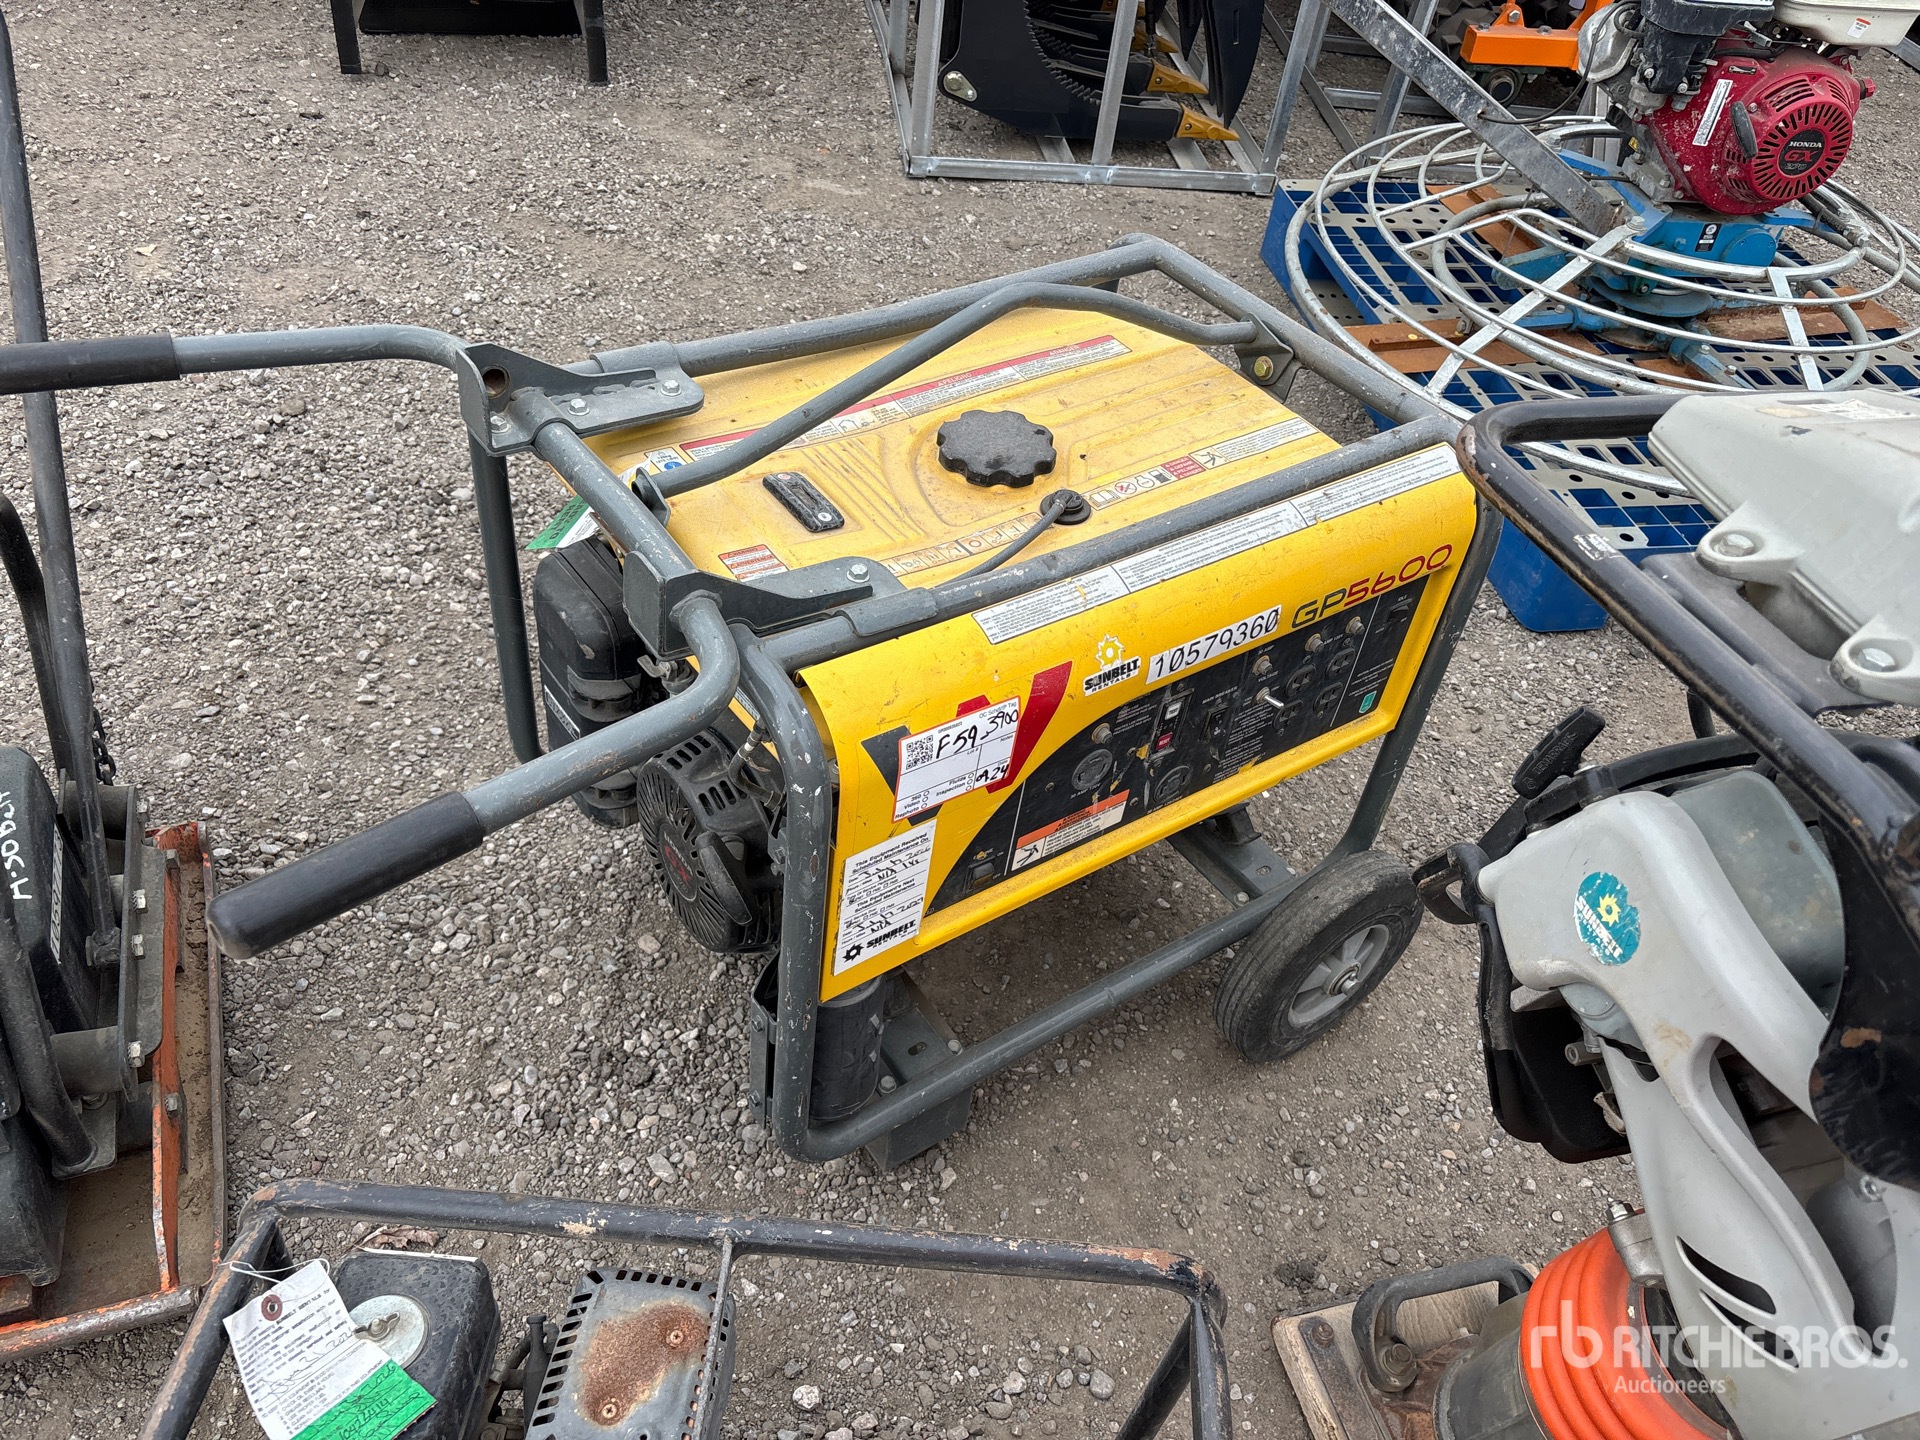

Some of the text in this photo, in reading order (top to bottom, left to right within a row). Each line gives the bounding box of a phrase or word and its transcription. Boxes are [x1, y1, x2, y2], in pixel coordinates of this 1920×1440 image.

[1784, 150, 1819, 162] GX
[1291, 543, 1453, 629] GP5600
[1154, 607, 1280, 678] 10579360
[1084, 656, 1141, 691] SUNBELT
[1091, 673, 1131, 694] RENTALS
[936, 782, 966, 797] Inspection
[664, 830, 693, 877] HONDA
[852, 858, 883, 874] Scheduled
[883, 841, 919, 860] Maintenance
[856, 832, 928, 867] This Equipment Received
[854, 882, 916, 913] Scheduled Maintenance
[869, 883, 902, 900] Equipment's
[902, 878, 915, 886] Next
[866, 919, 917, 948] SUNBELT
